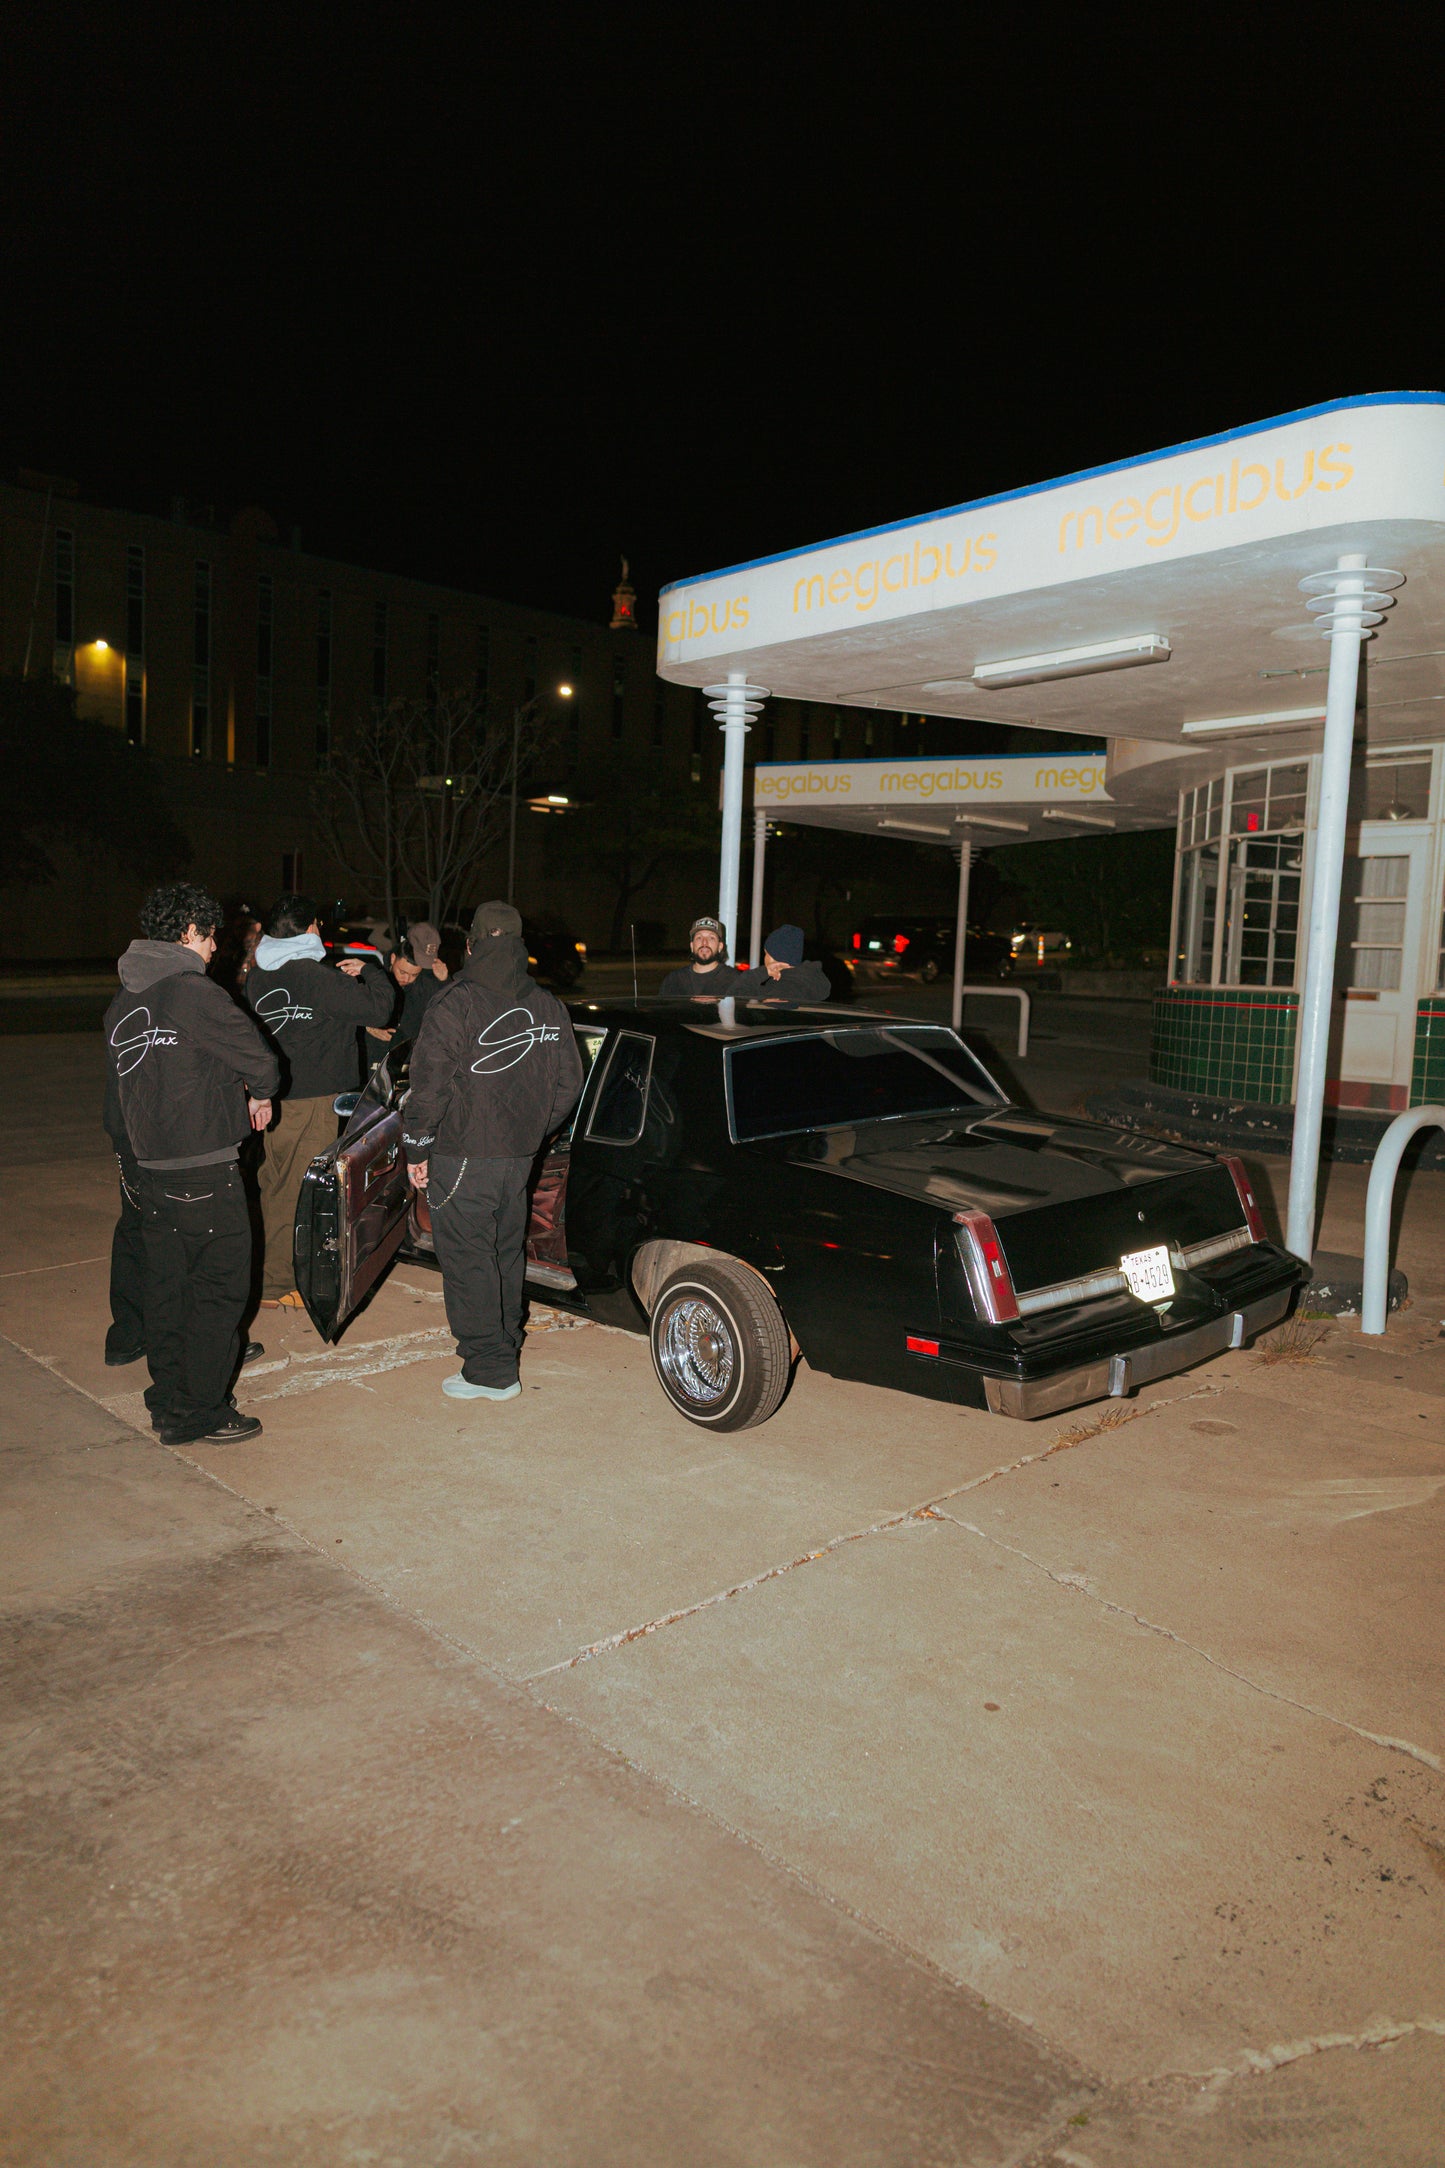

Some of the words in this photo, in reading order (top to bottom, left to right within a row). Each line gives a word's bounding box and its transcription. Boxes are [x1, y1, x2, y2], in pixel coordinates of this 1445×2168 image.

[793, 530, 998, 613] megabus
[1058, 441, 1355, 549] megabus
[879, 768, 1004, 798] megabus
[255, 988, 313, 1035] Stax
[110, 1006, 178, 1077] Stax
[470, 1007, 560, 1074] Stax
[1130, 1253, 1153, 1266] TEXAS
